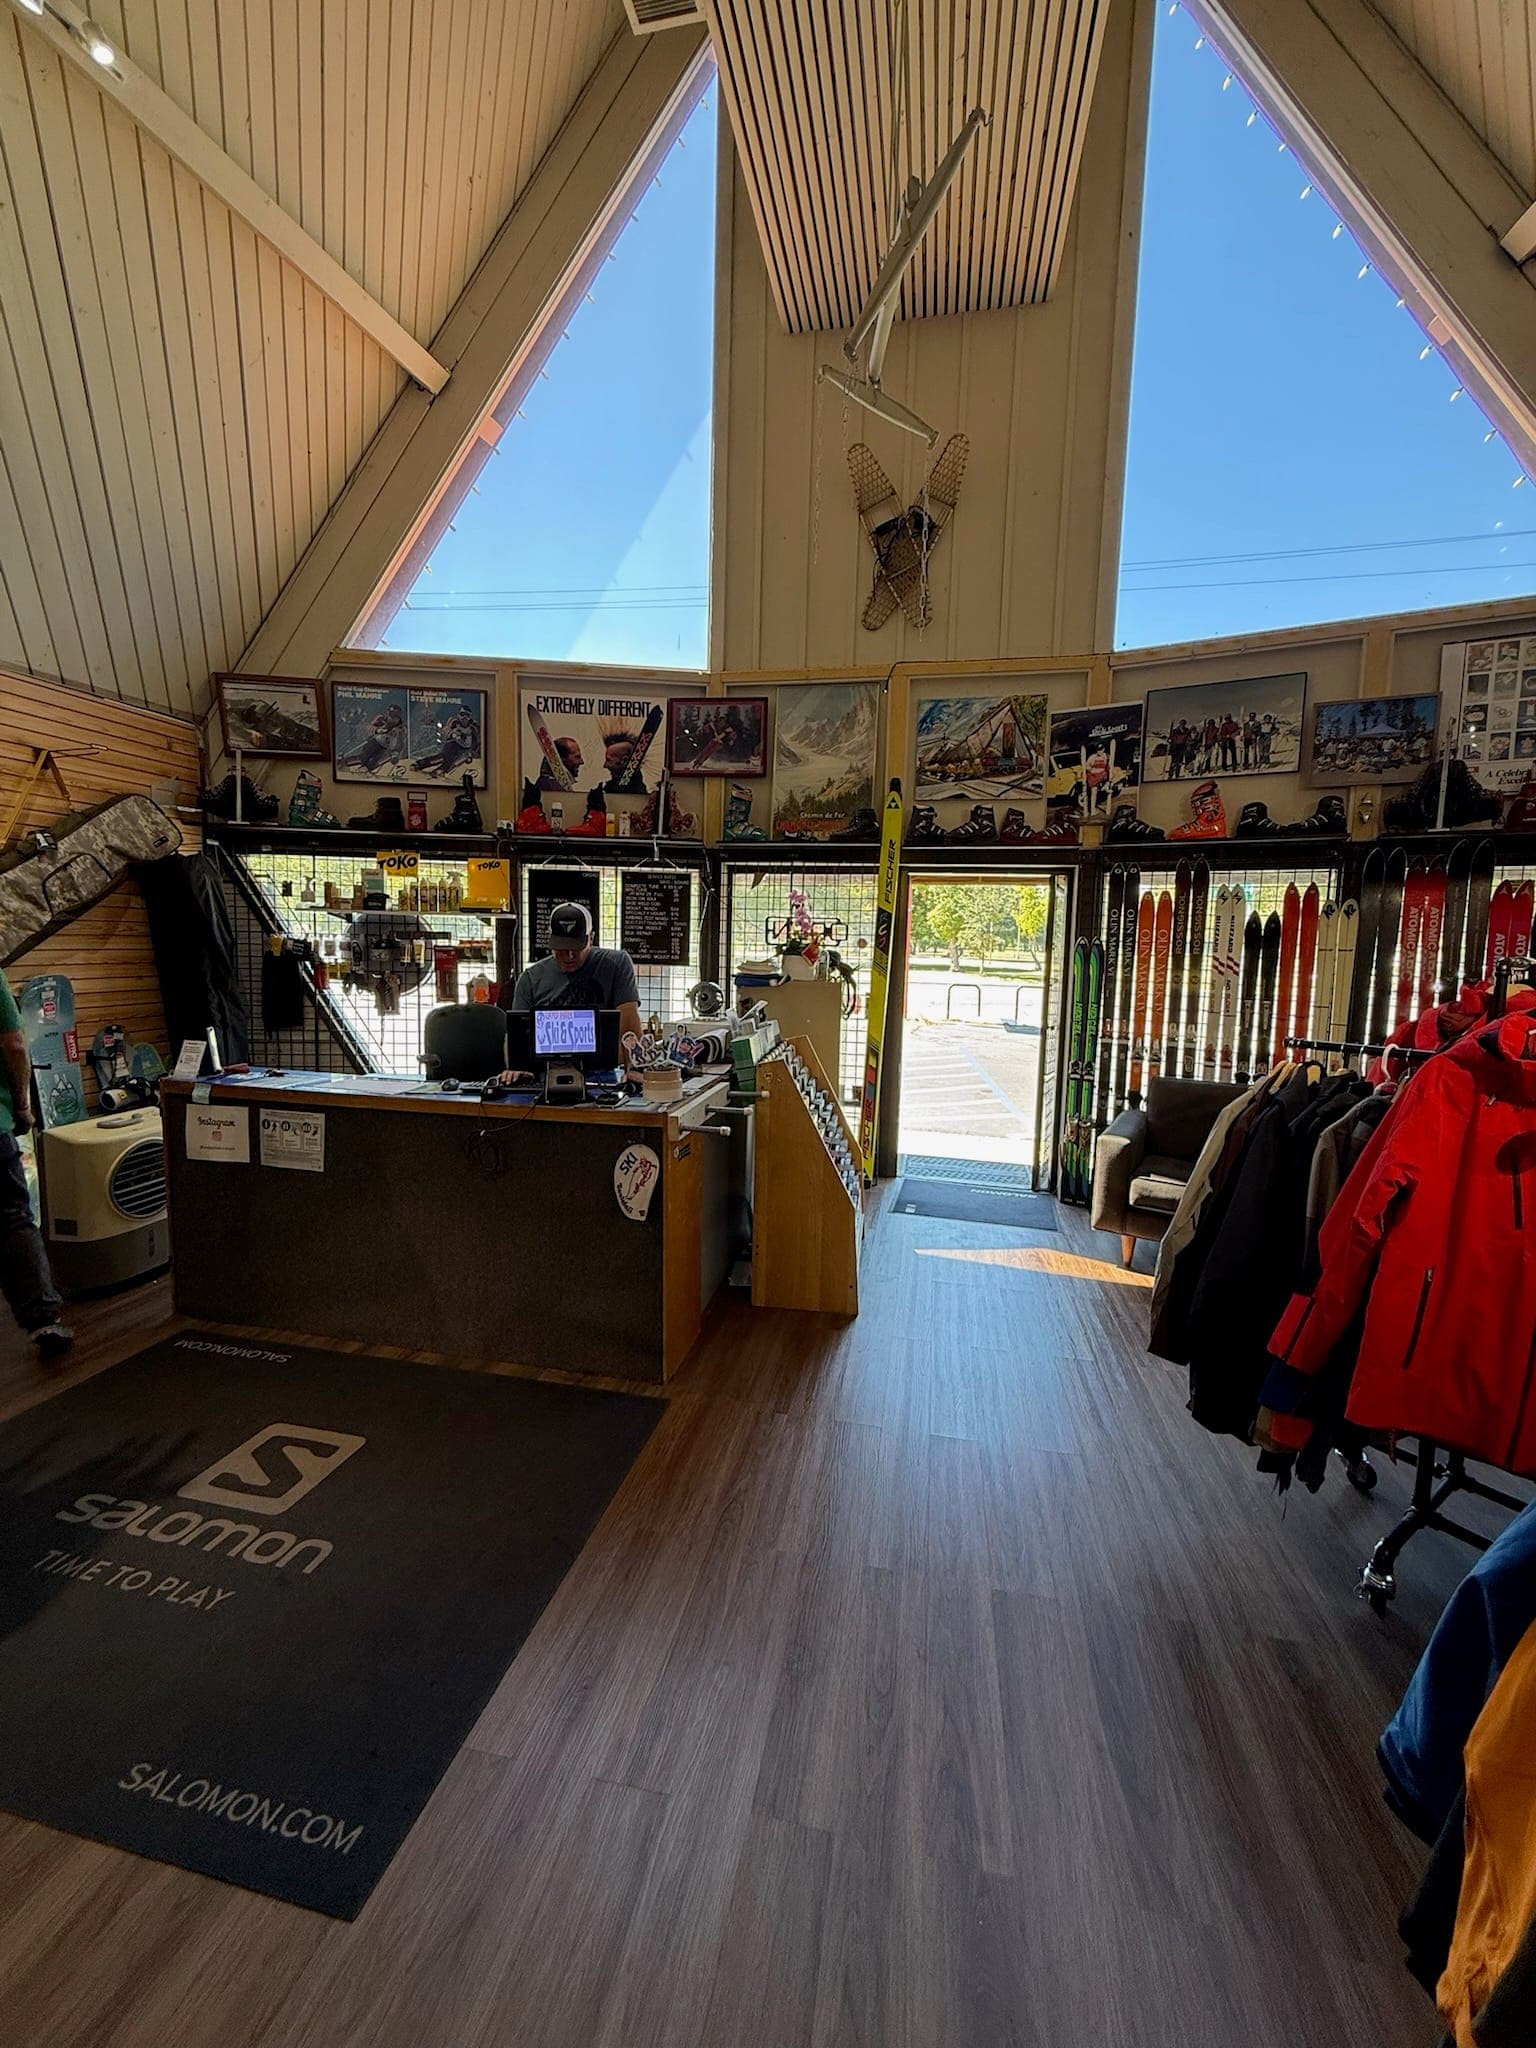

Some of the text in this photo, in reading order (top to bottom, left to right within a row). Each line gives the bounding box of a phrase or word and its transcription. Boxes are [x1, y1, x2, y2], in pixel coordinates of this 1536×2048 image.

[536, 696, 652, 718] EXTREMELY DIFFERENT
[1496, 769, 1527, 779] Celebr
[377, 855, 418, 870] TOKO
[478, 860, 500, 870] TOKO
[884, 839, 896, 904] FISCHER
[1110, 908, 1120, 934] OLIN
[1126, 908, 1135, 934] OLIN
[1175, 892, 1186, 954] ROSSIGNOL
[1193, 892, 1205, 954] ROSSIGNOL
[1324, 904, 1336, 920] K2
[1344, 904, 1356, 920] K2
[1213, 915, 1222, 954] BLIZZARD
[1228, 915, 1236, 954] BLIZZARD
[1406, 906, 1419, 950] ATOMIC
[1428, 906, 1440, 950] ATOMIC
[1108, 937, 1118, 964] MARK
[1124, 937, 1134, 966] MARK
[1515, 933, 1527, 958] ATO
[1136, 928, 1152, 1016] OLIN MARK IV
[1154, 929, 1169, 1016] OLIN MARK IV
[546, 1020, 594, 1046] Ski & Sports
[197, 1116, 236, 1130] Instagram
[864, 1100, 872, 1160] FISCHER
[619, 1152, 638, 1176] SKI
[174, 1339, 292, 1363] SALOMON.COM
[55, 1493, 334, 1574] salomon
[32, 1549, 236, 1612] TIME TO PLAY
[118, 1762, 365, 1854] SALOMON.COM
